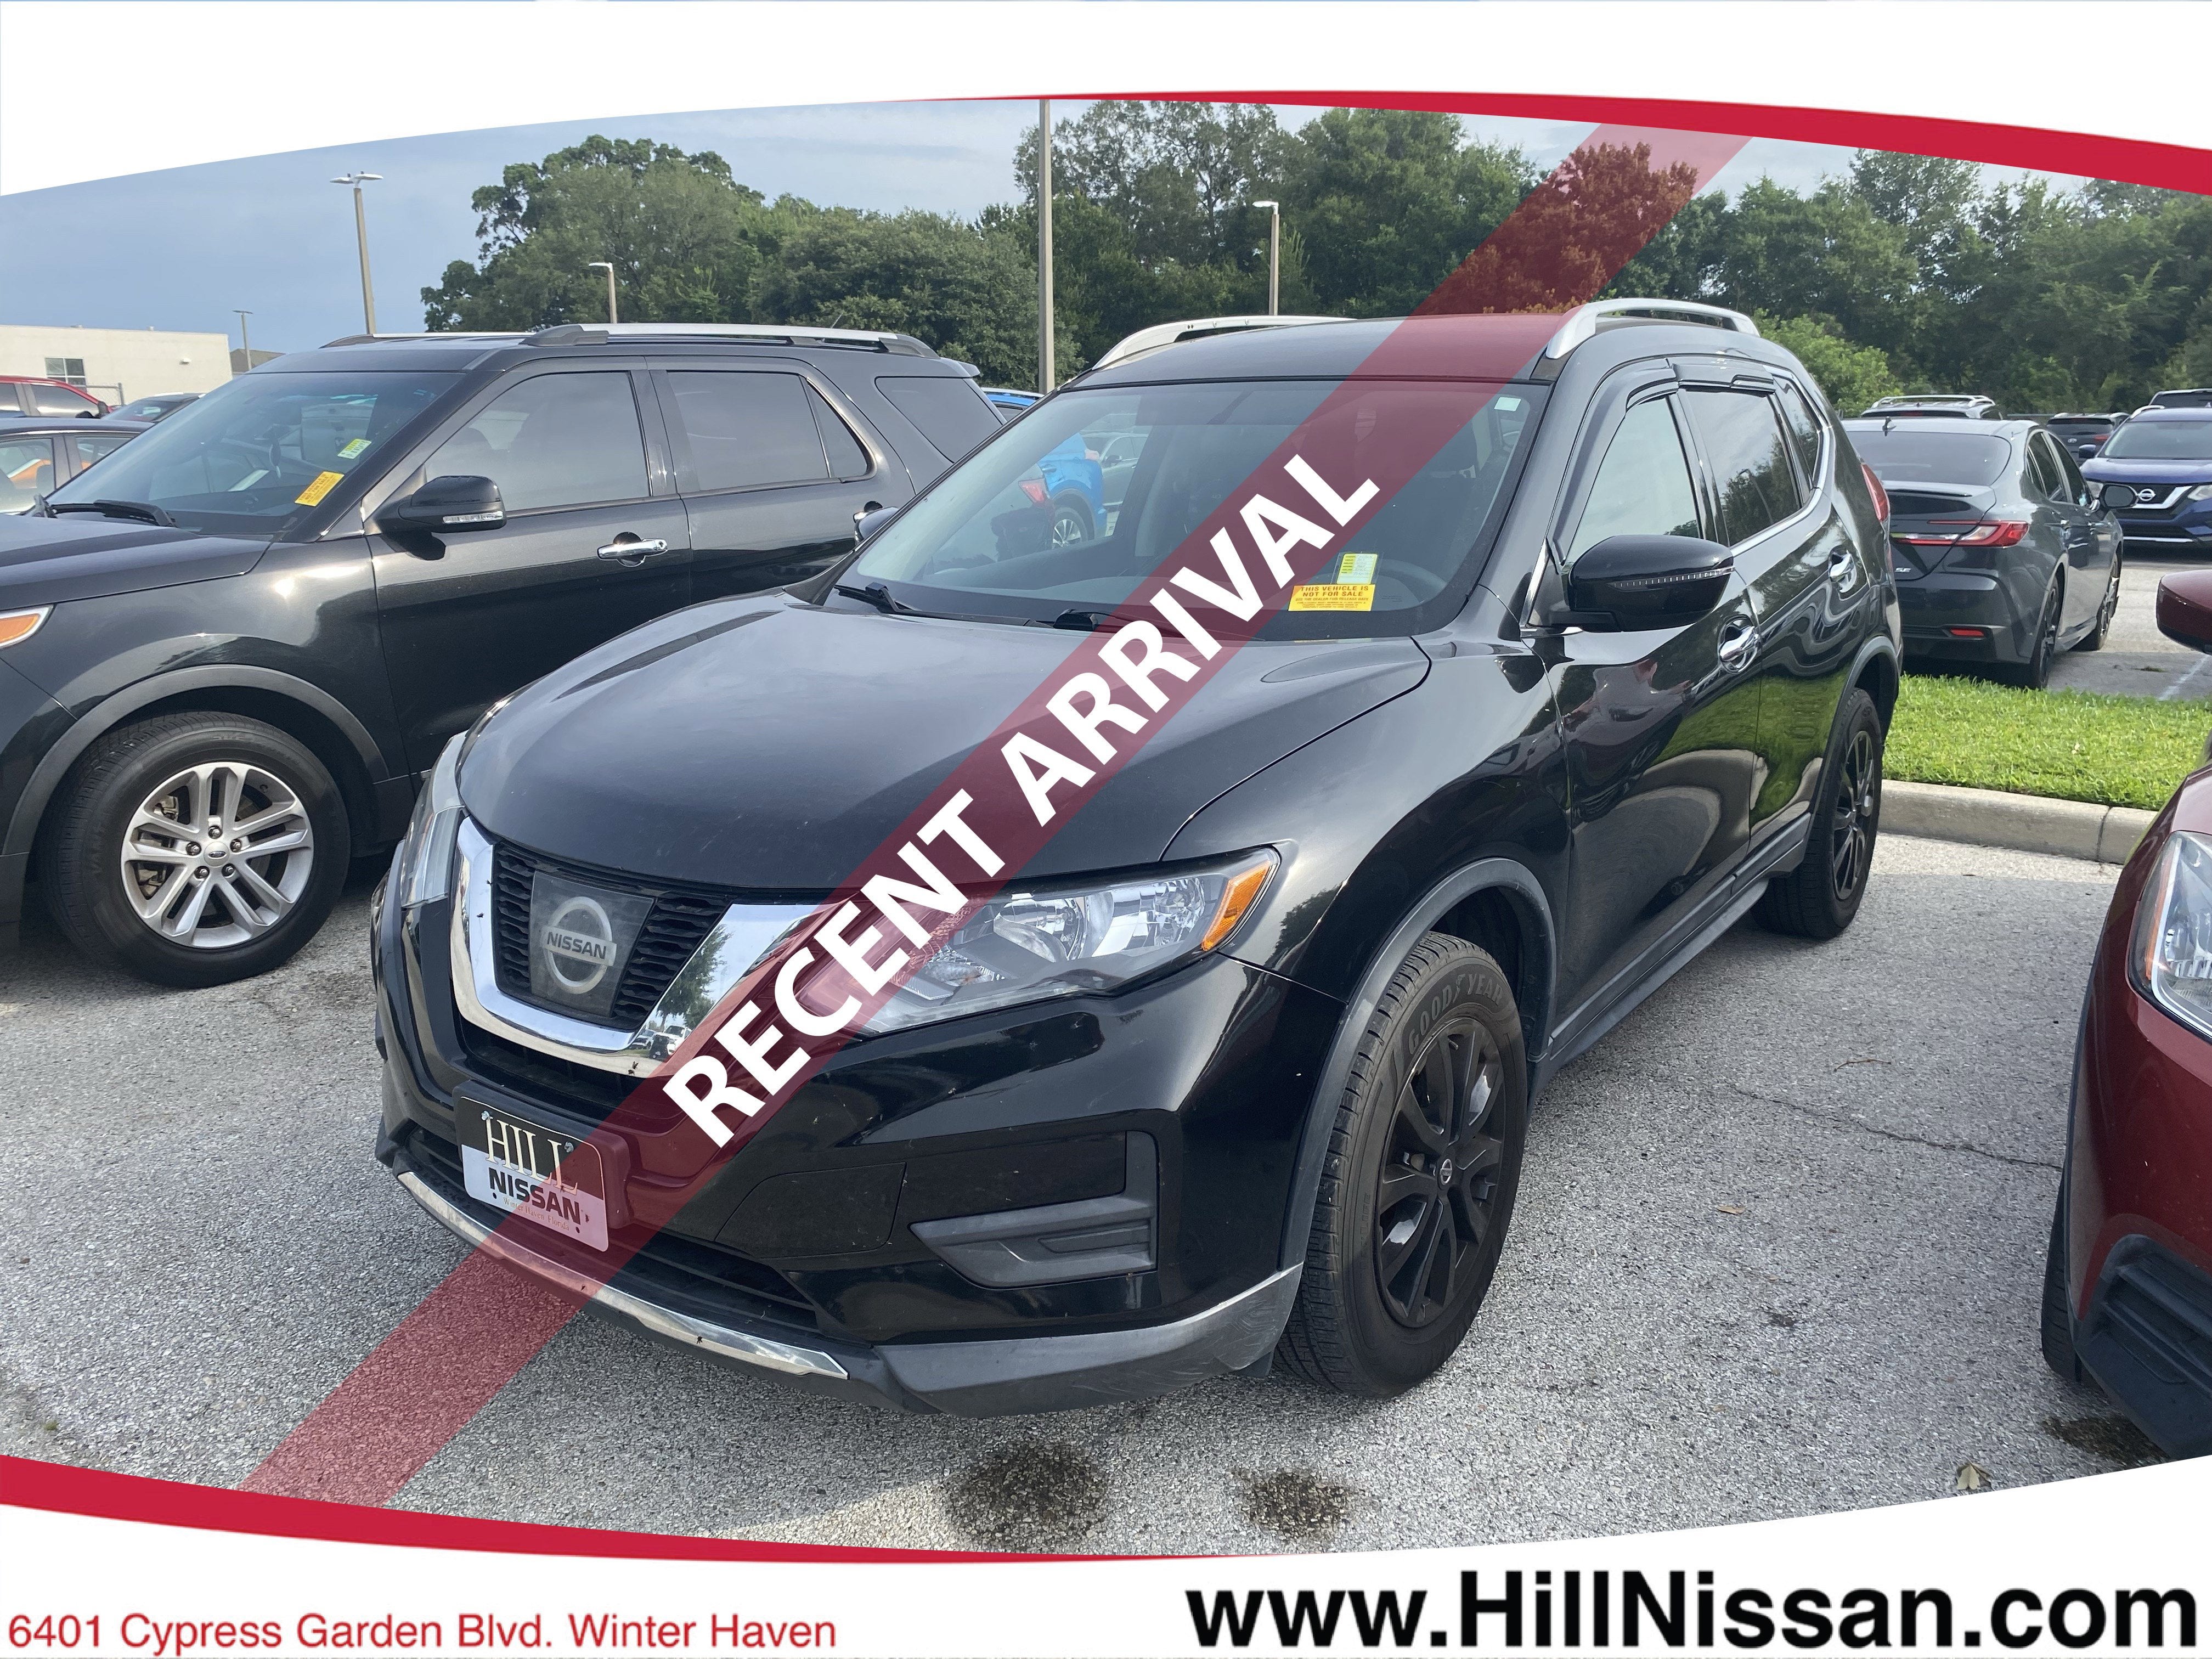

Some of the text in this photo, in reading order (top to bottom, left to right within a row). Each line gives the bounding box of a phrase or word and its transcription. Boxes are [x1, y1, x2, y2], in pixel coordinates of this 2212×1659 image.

[546, 932, 607, 960] NISSAN
[1408, 973, 1503, 1054] GOODYEAR
[486, 1116, 578, 1195] HILL
[488, 1167, 582, 1225] NISSAN
[503, 1196, 569, 1231] Winter Haven Florida
